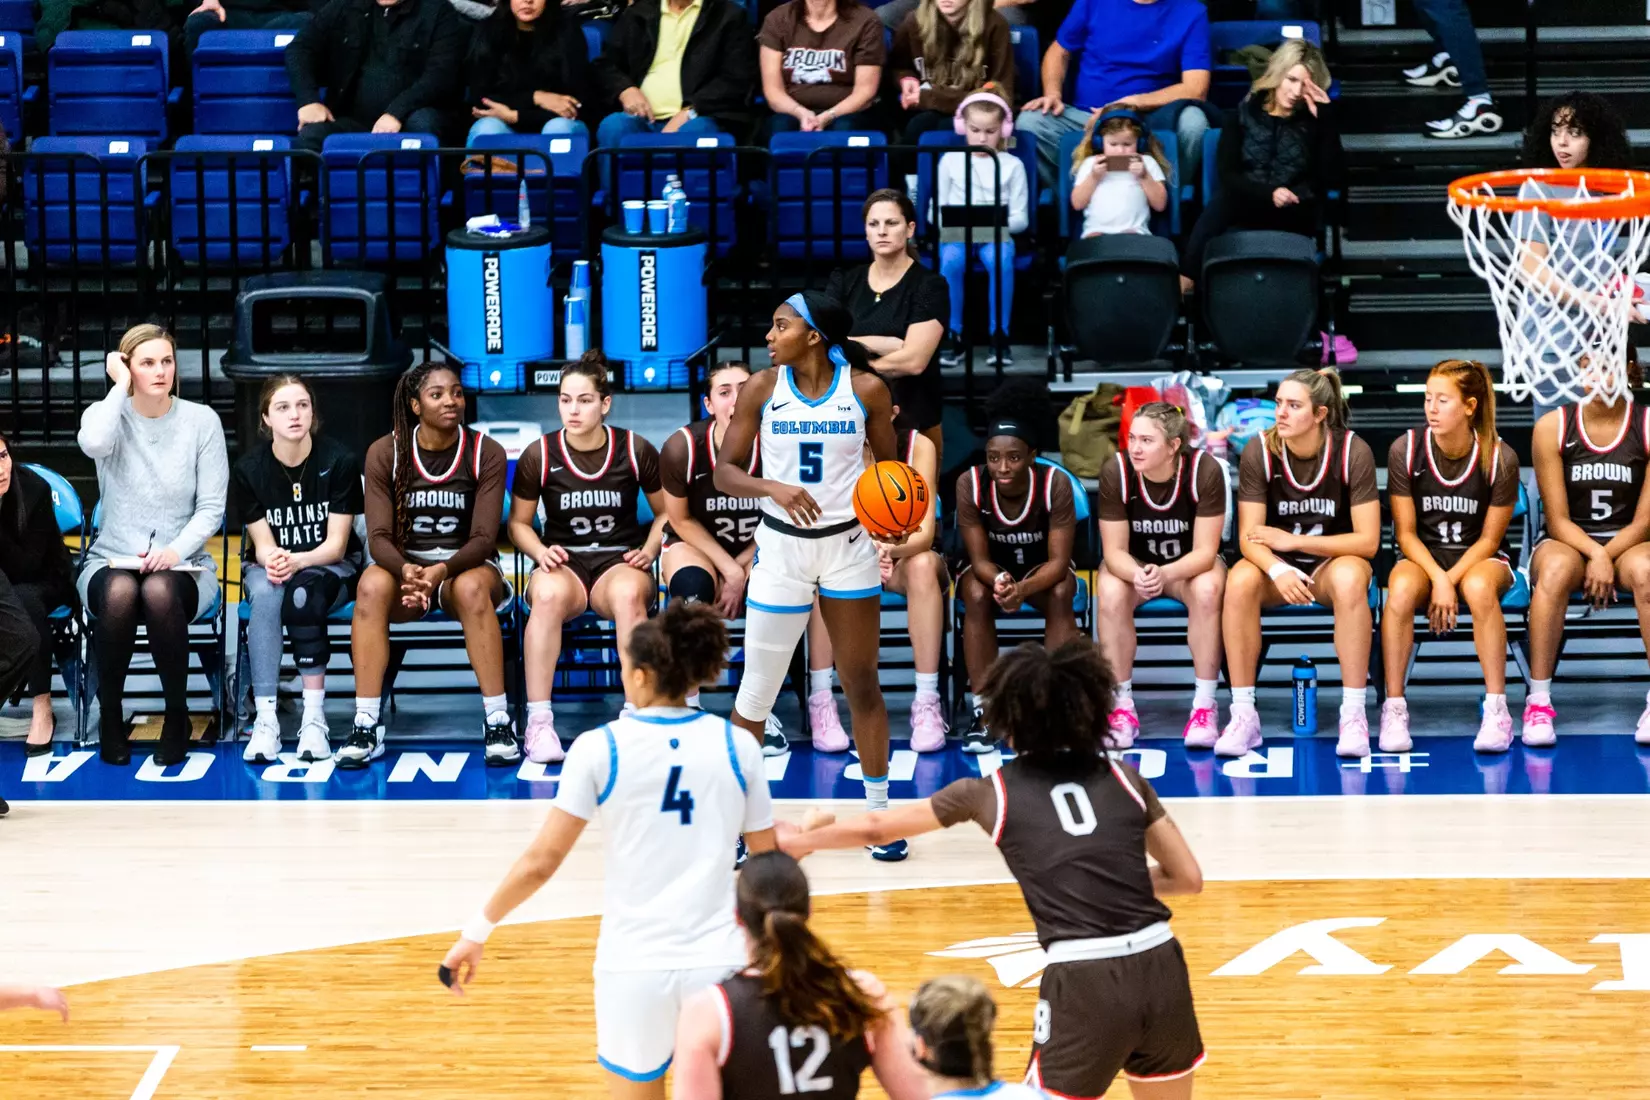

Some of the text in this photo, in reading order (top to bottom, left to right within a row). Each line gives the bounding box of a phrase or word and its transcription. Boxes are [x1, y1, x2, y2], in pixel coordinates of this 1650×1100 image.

[484, 257, 501, 352] POWERADE
[641, 255, 656, 349] POWERADE
[771, 421, 857, 435] COLUMBIA
[799, 442, 824, 484] 5
[1571, 462, 1633, 484] BROWN
[404, 490, 466, 510] BROWN
[560, 490, 622, 511] BROWN
[1277, 497, 1336, 517] BROWN
[1422, 495, 1479, 515] BROWN
[1591, 490, 1614, 521] 5
[266, 501, 330, 526] AGAINST
[279, 524, 323, 546] HATE
[714, 516, 759, 543] 25
[1131, 518, 1190, 535] BROWN
[1013, 548, 1025, 565] 1
[1146, 539, 1182, 560] 10
[1296, 680, 1305, 726] POWERADE
[660, 765, 695, 825] 4
[1050, 782, 1098, 837] 0
[768, 1025, 834, 1095] 12
